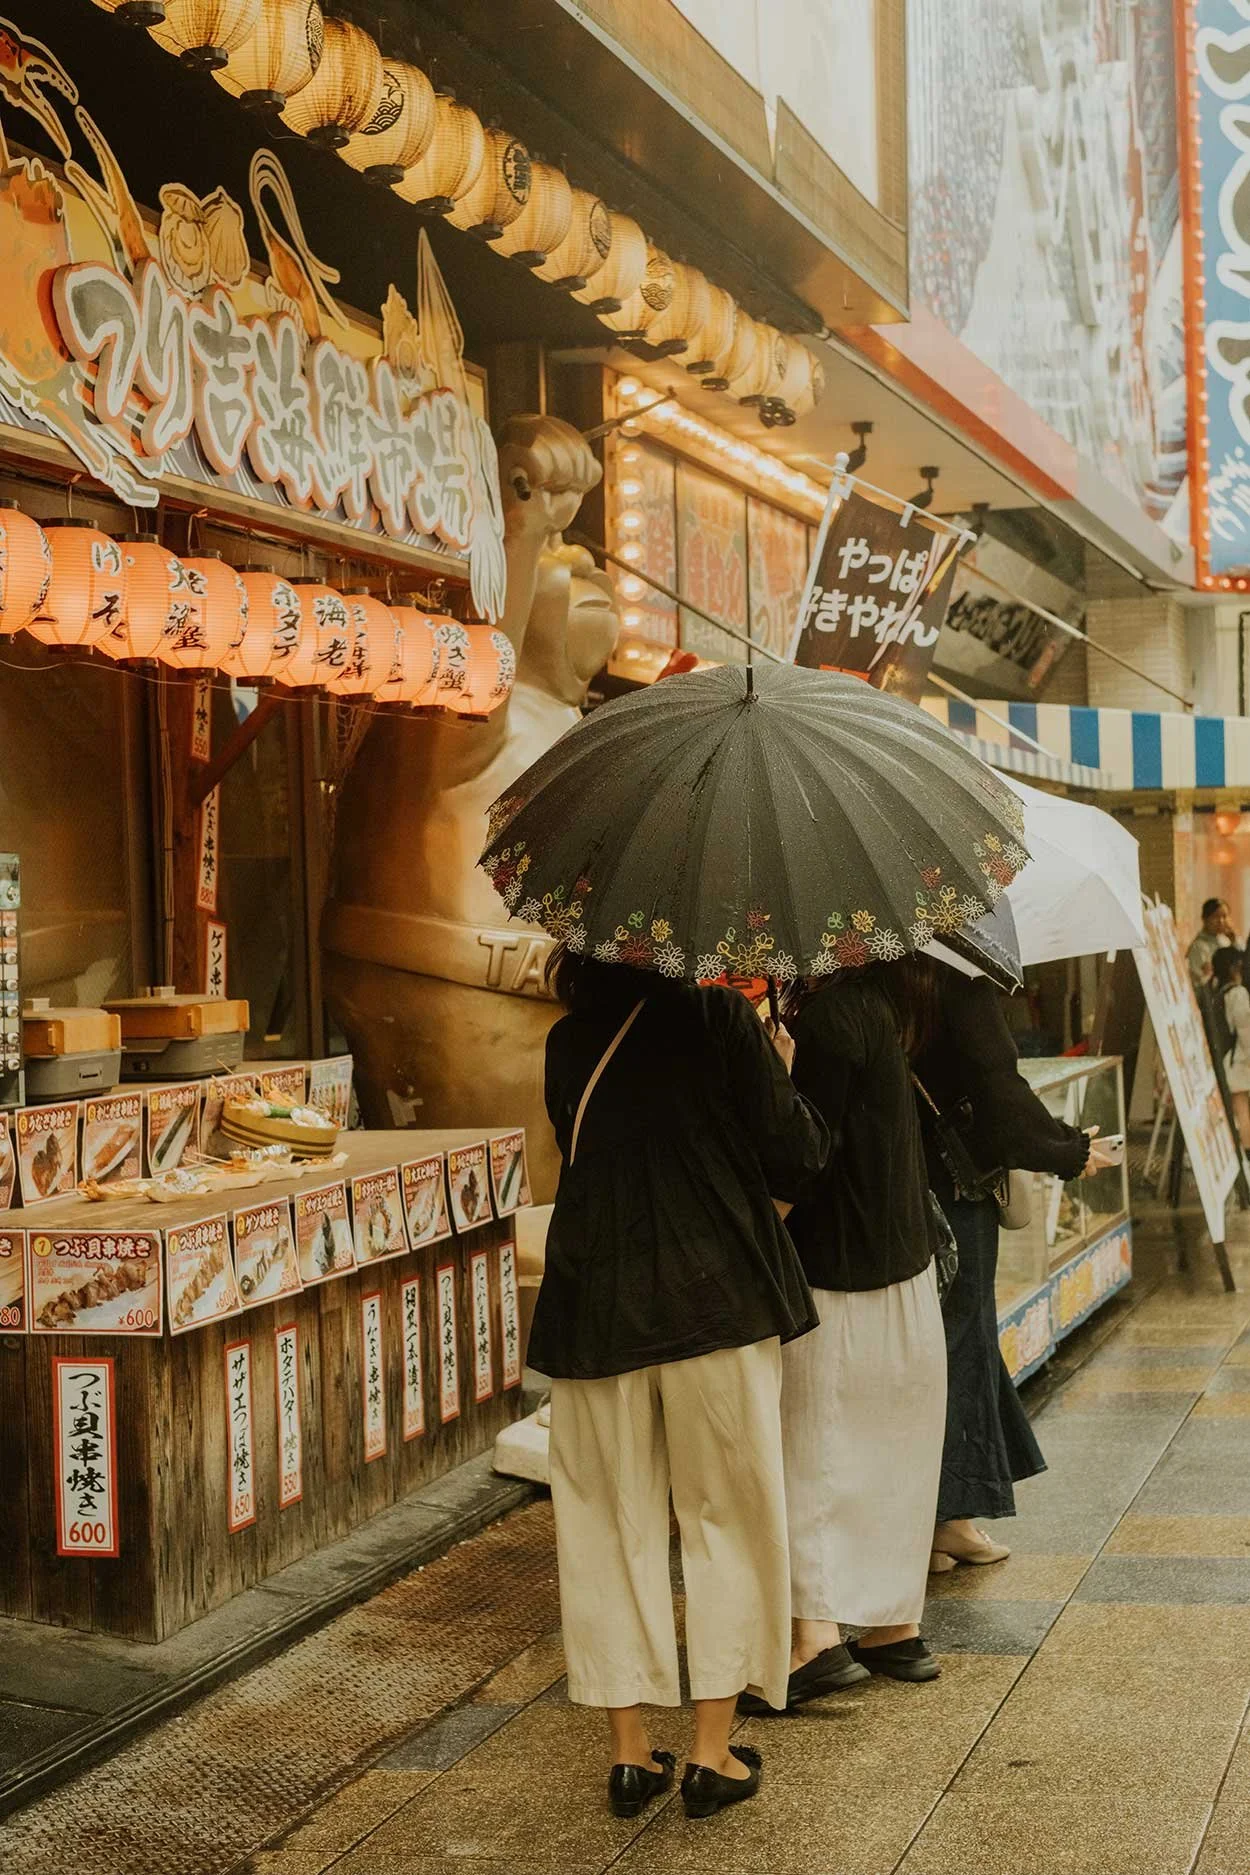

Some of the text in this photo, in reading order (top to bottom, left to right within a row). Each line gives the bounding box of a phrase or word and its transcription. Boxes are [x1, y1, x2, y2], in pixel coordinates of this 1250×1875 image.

[54, 258, 474, 551] つり吉海鮮市場
[838, 537, 929, 594] やっぱ
[314, 597, 348, 667] 海老
[54, 1236, 151, 1259] つぶ貝串焼き
[179, 1220, 224, 1251] つぶ貝串焼き
[119, 1309, 154, 1327] ¥600
[67, 1373, 106, 1517] つぶ貝串焼き
[234, 1494, 250, 1518] 650
[69, 1521, 106, 1544] 600
